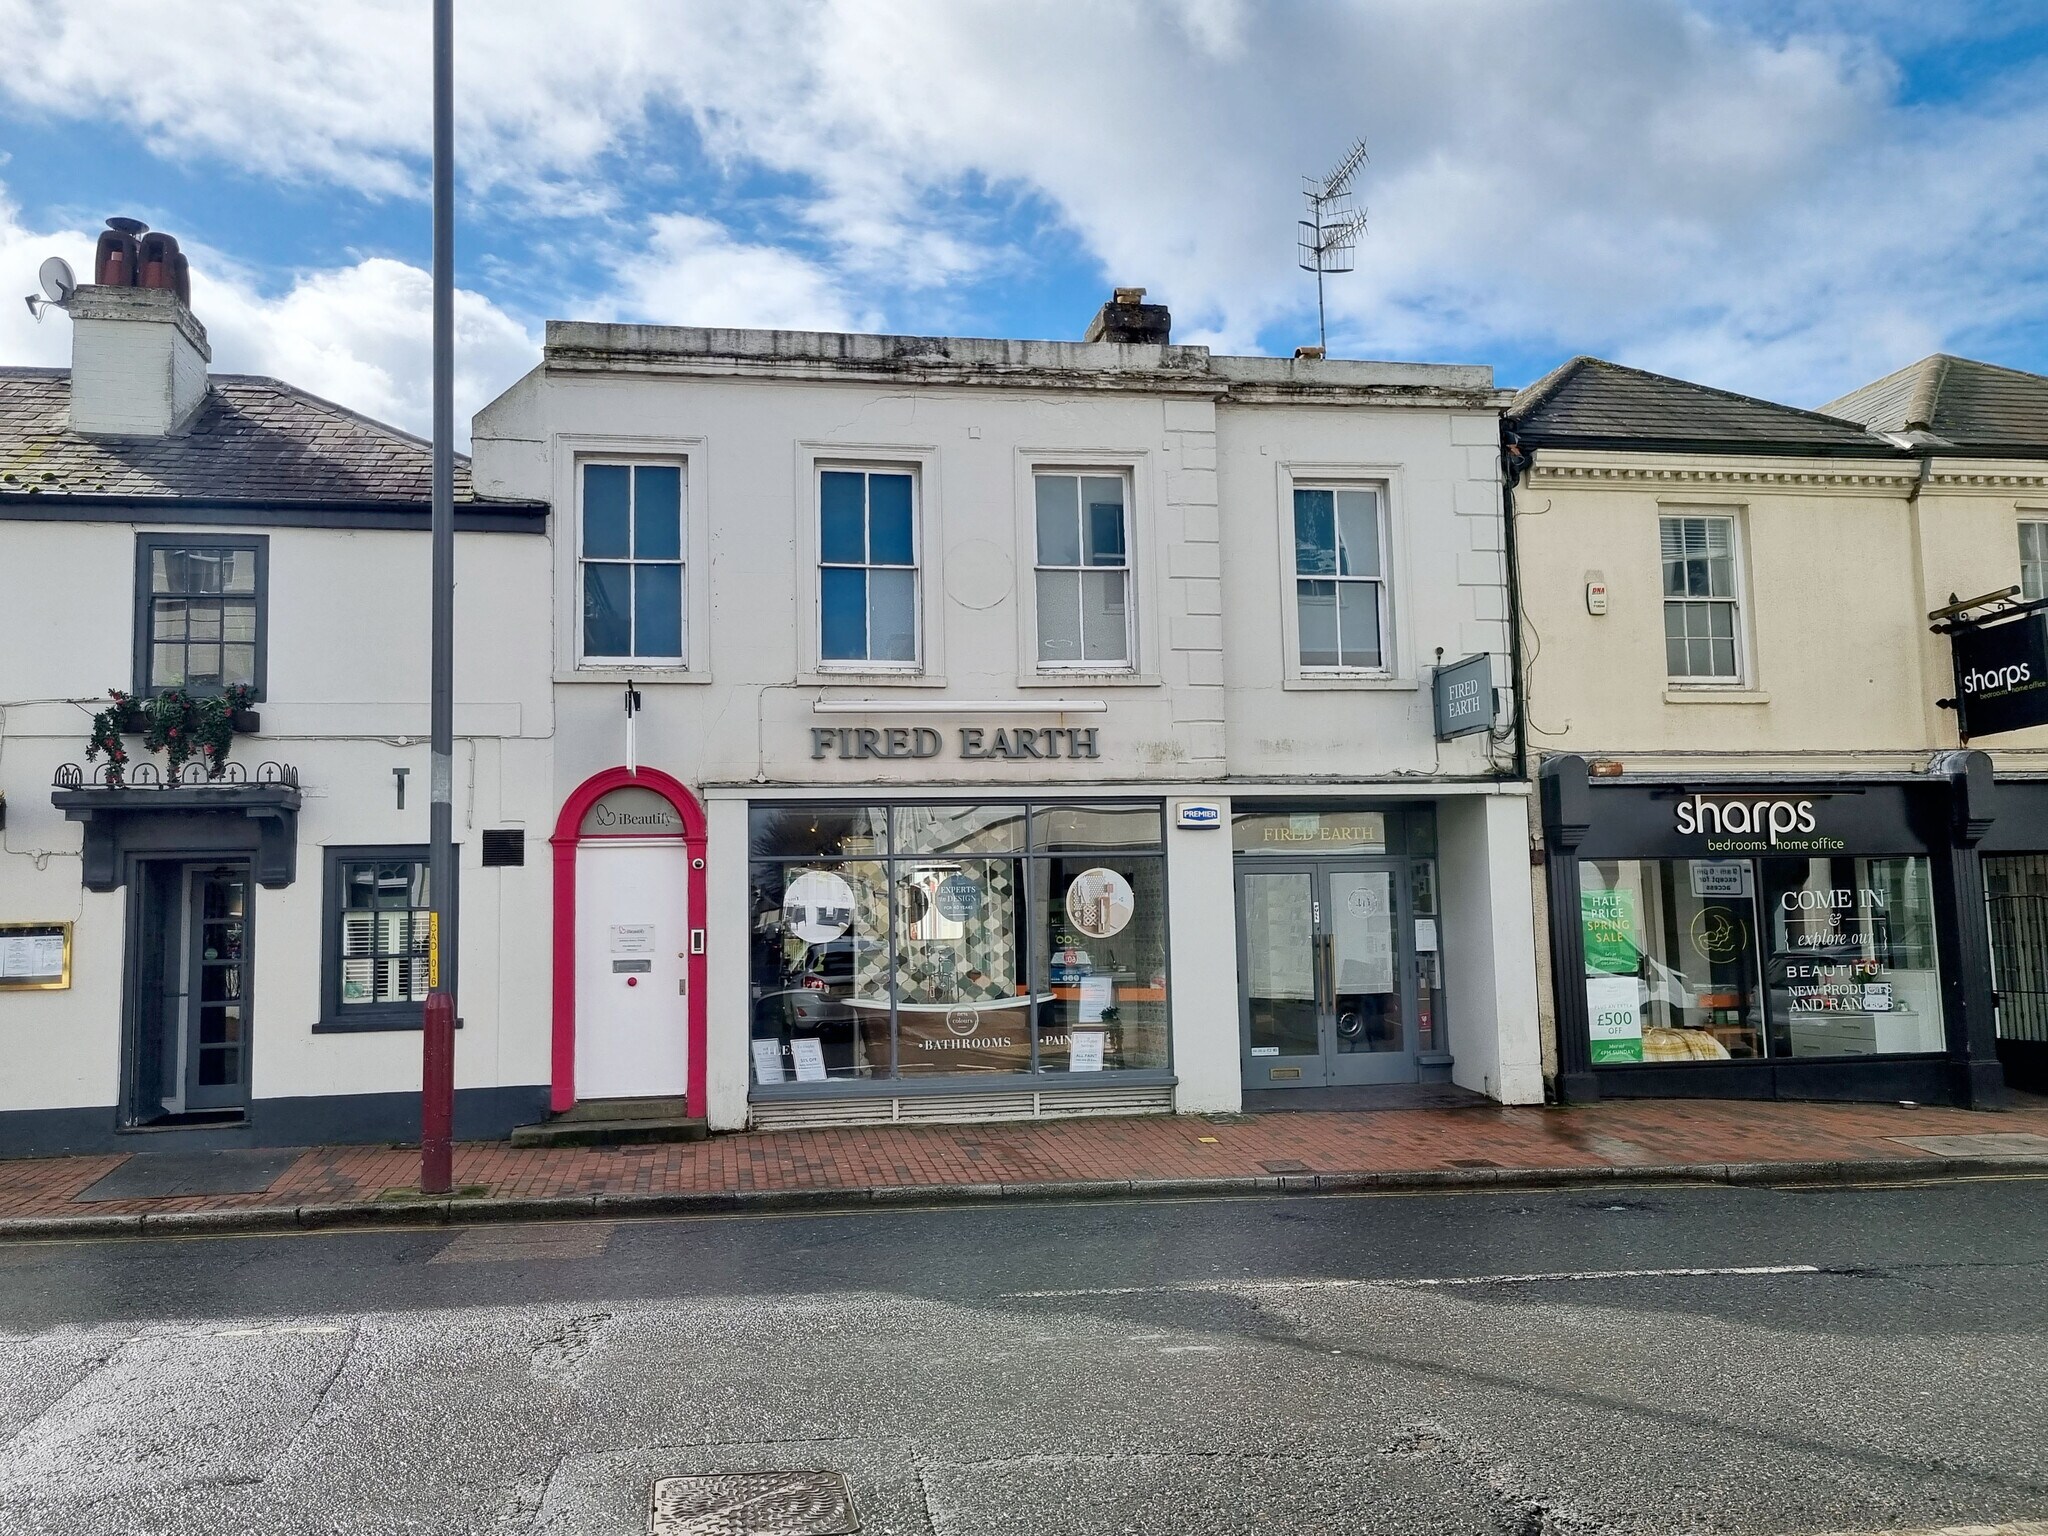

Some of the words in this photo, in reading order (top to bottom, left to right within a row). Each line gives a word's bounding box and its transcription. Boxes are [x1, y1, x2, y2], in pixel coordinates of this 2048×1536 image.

[1964, 662, 2031, 694] sharps
[1448, 679, 1478, 701] FIRED
[2012, 684, 2028, 693] home
[2028, 681, 2047, 690] office
[1448, 696, 1481, 718] EARTH
[811, 727, 943, 759] FIRED
[959, 727, 1101, 759] EARTH
[619, 812, 671, 827] iBeautify
[1184, 810, 1218, 818] PREMIER
[1676, 794, 1816, 845] sharps
[1263, 828, 1314, 841] FIRED
[1320, 826, 1375, 841] EARTH
[1707, 838, 1768, 851] bedrooms
[1776, 838, 1809, 850] home
[1811, 837, 1845, 850] office
[940, 886, 976, 894] EXPERTS
[1592, 895, 1621, 907] HALF
[1781, 889, 1852, 911] COME
[1859, 888, 1885, 908] IN
[1591, 907, 1624, 919] PRICE
[1828, 913, 1842, 927] &
[1587, 920, 1630, 931] SPRING
[1596, 931, 1624, 943] SALE
[1798, 928, 1847, 951] explore
[1851, 932, 1874, 946] our
[1786, 963, 1892, 979] BEAUTIFUL
[1787, 985, 1819, 997] NEW
[1789, 998, 1824, 1012] AND
[1597, 1011, 1632, 1026] £500
[1608, 1027, 1622, 1035] OFF
[924, 1037, 1012, 1051] BATHROOMS
[1045, 1035, 1073, 1046] PAIN
